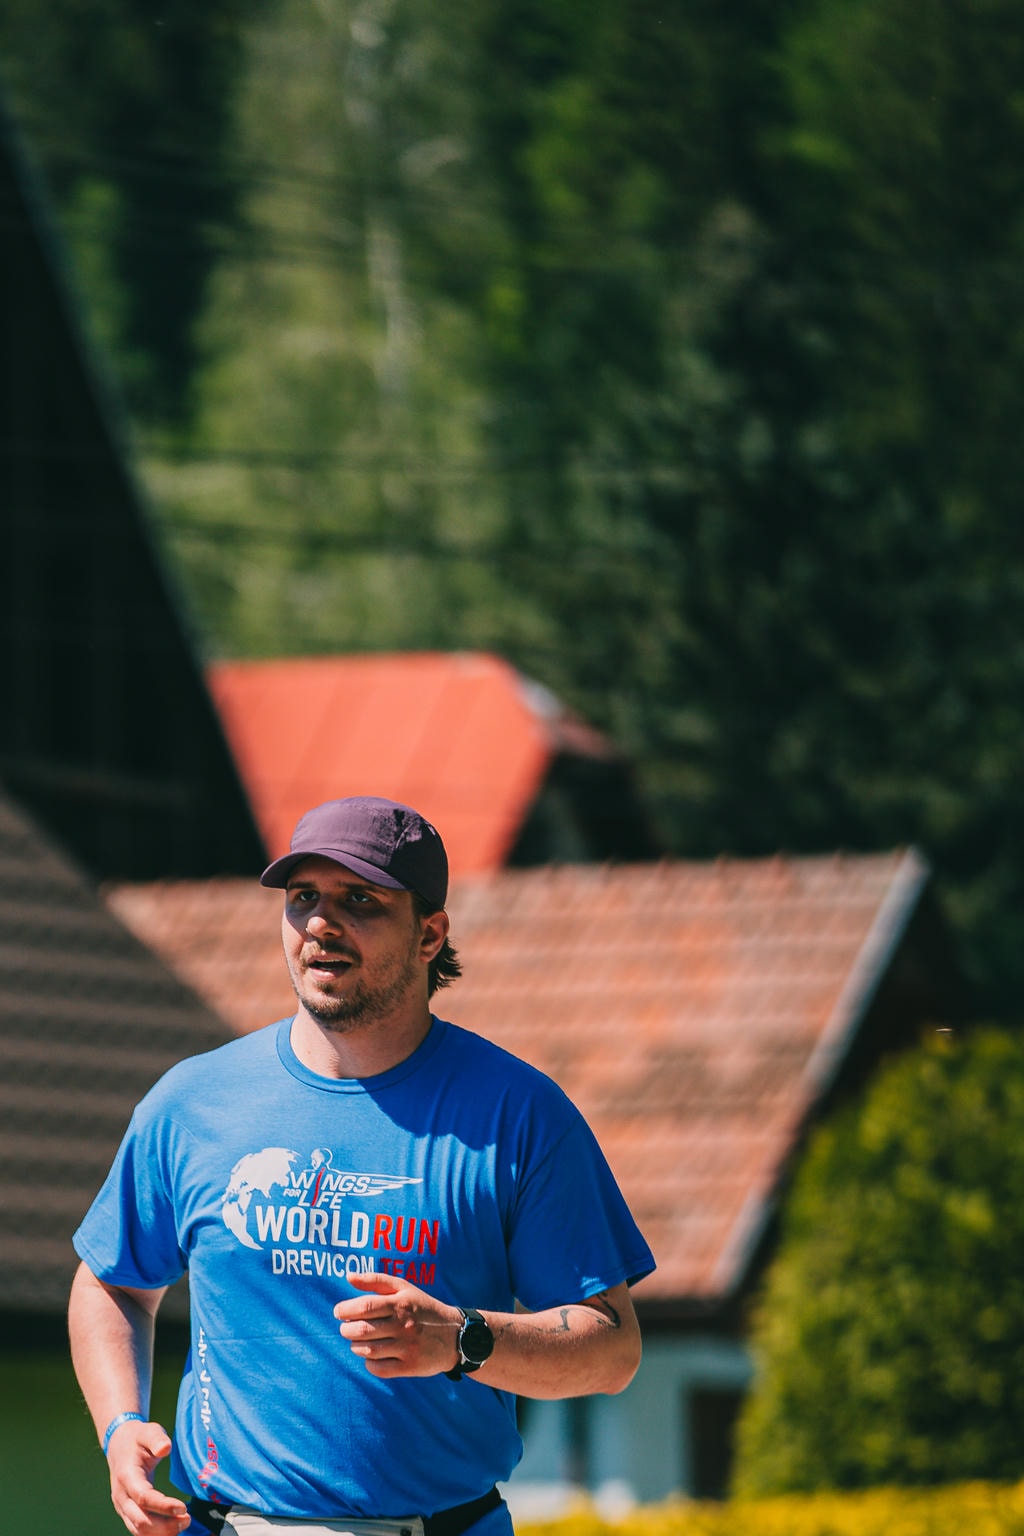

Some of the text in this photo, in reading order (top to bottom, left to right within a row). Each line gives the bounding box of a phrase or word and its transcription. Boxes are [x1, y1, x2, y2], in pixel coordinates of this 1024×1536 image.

[290, 1169, 371, 1194] WINGS
[283, 1188, 346, 1210] FOR LIFE
[256, 1205, 440, 1255] WORLD RUN
[271, 1249, 436, 1286] DREVICOM TEAM
